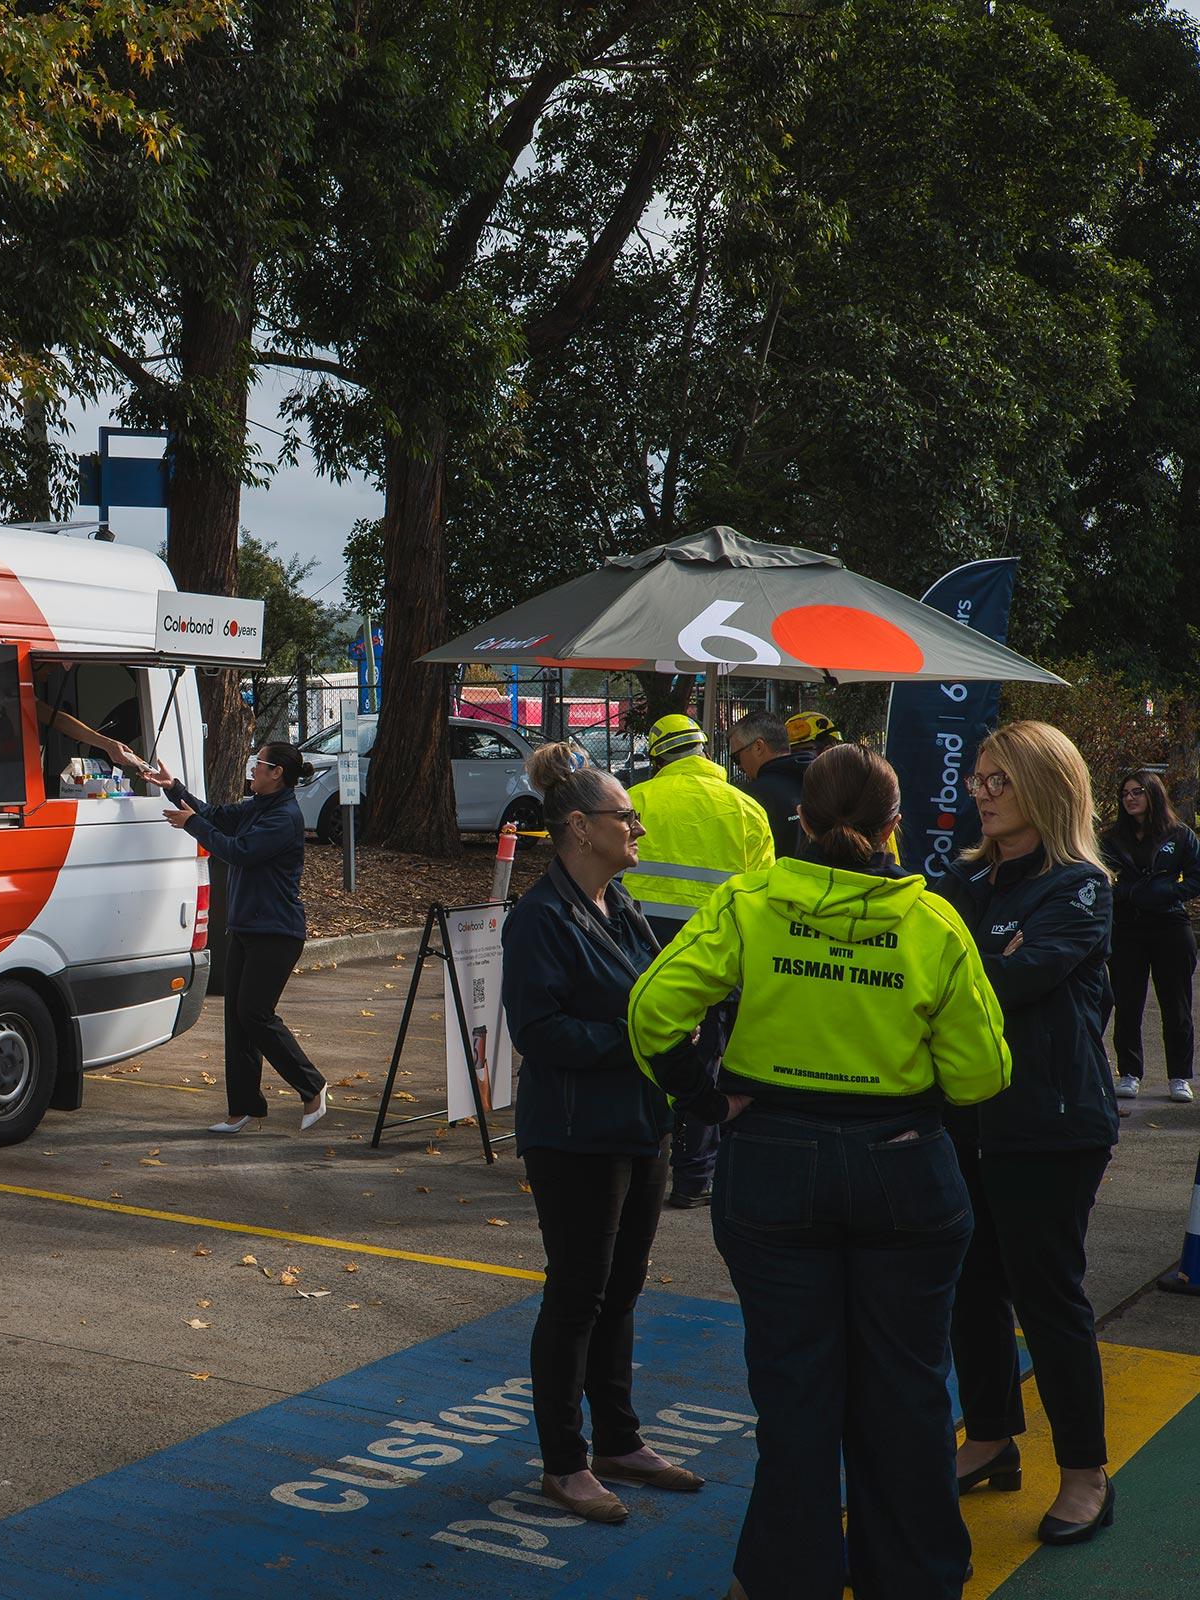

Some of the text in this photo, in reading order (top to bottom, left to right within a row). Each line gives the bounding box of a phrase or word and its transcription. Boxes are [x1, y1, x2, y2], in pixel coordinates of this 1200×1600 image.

[829, 946, 854, 959] WITH
[772, 956, 905, 990] TASMAN TANKS
[773, 1065, 880, 1084] www.tasmantanks.com.au
[270, 1376, 533, 1514] custom
